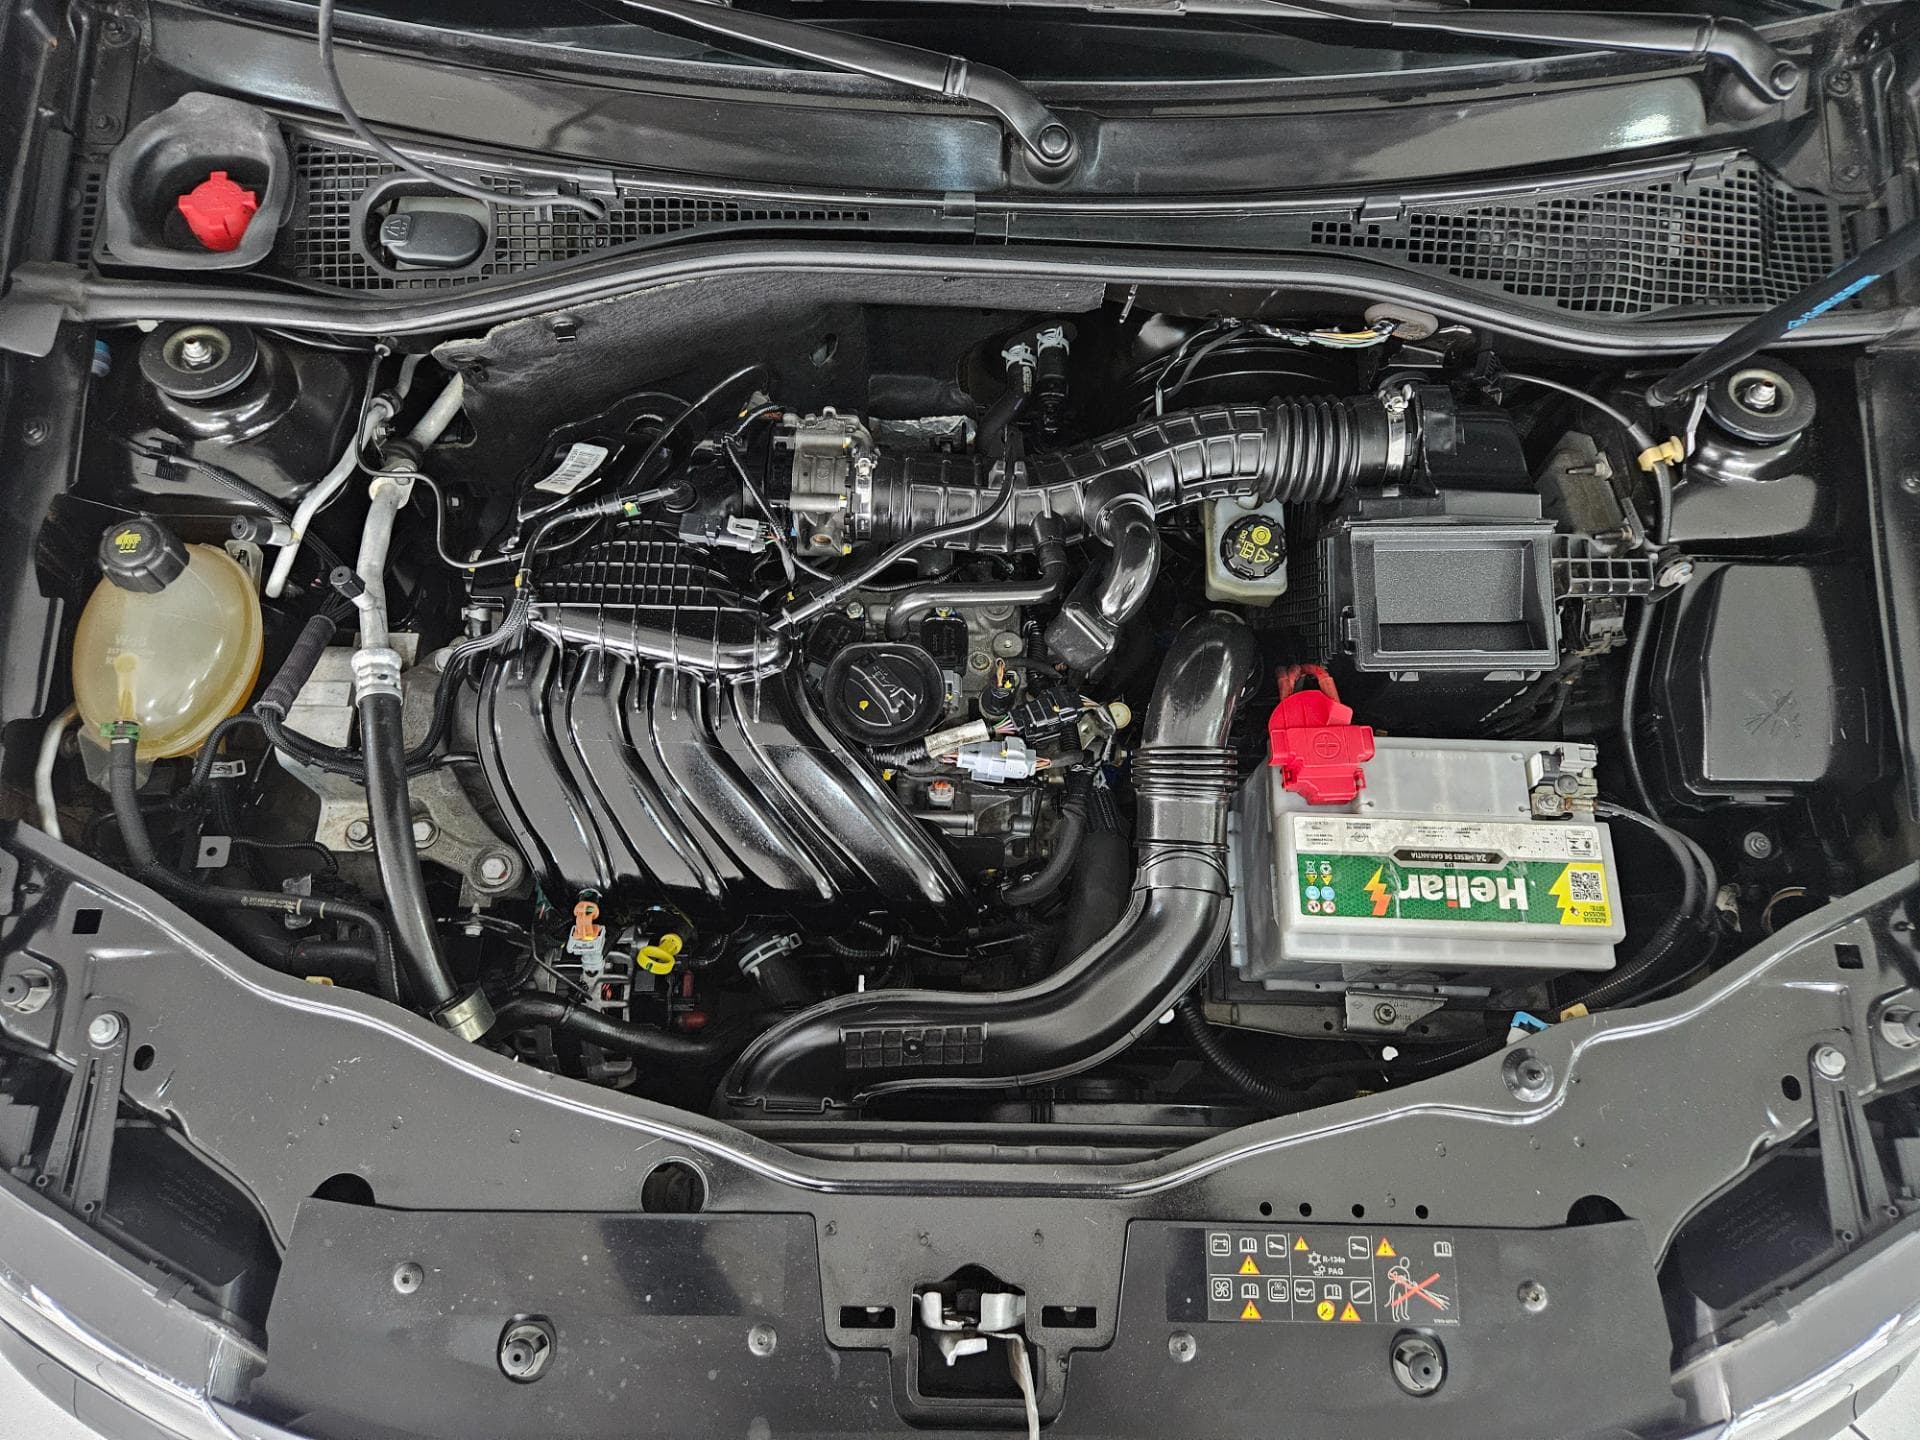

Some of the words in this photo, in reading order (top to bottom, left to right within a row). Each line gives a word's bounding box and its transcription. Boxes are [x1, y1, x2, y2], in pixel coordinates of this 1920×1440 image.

[1410, 852, 1443, 860] GARANTIA
[1453, 853, 1474, 861] MESES
[1476, 853, 1487, 862] 24
[1398, 874, 1529, 910] Heliar
[1322, 1255, 1346, 1264] R-134a
[1328, 1267, 1344, 1276] PAG
